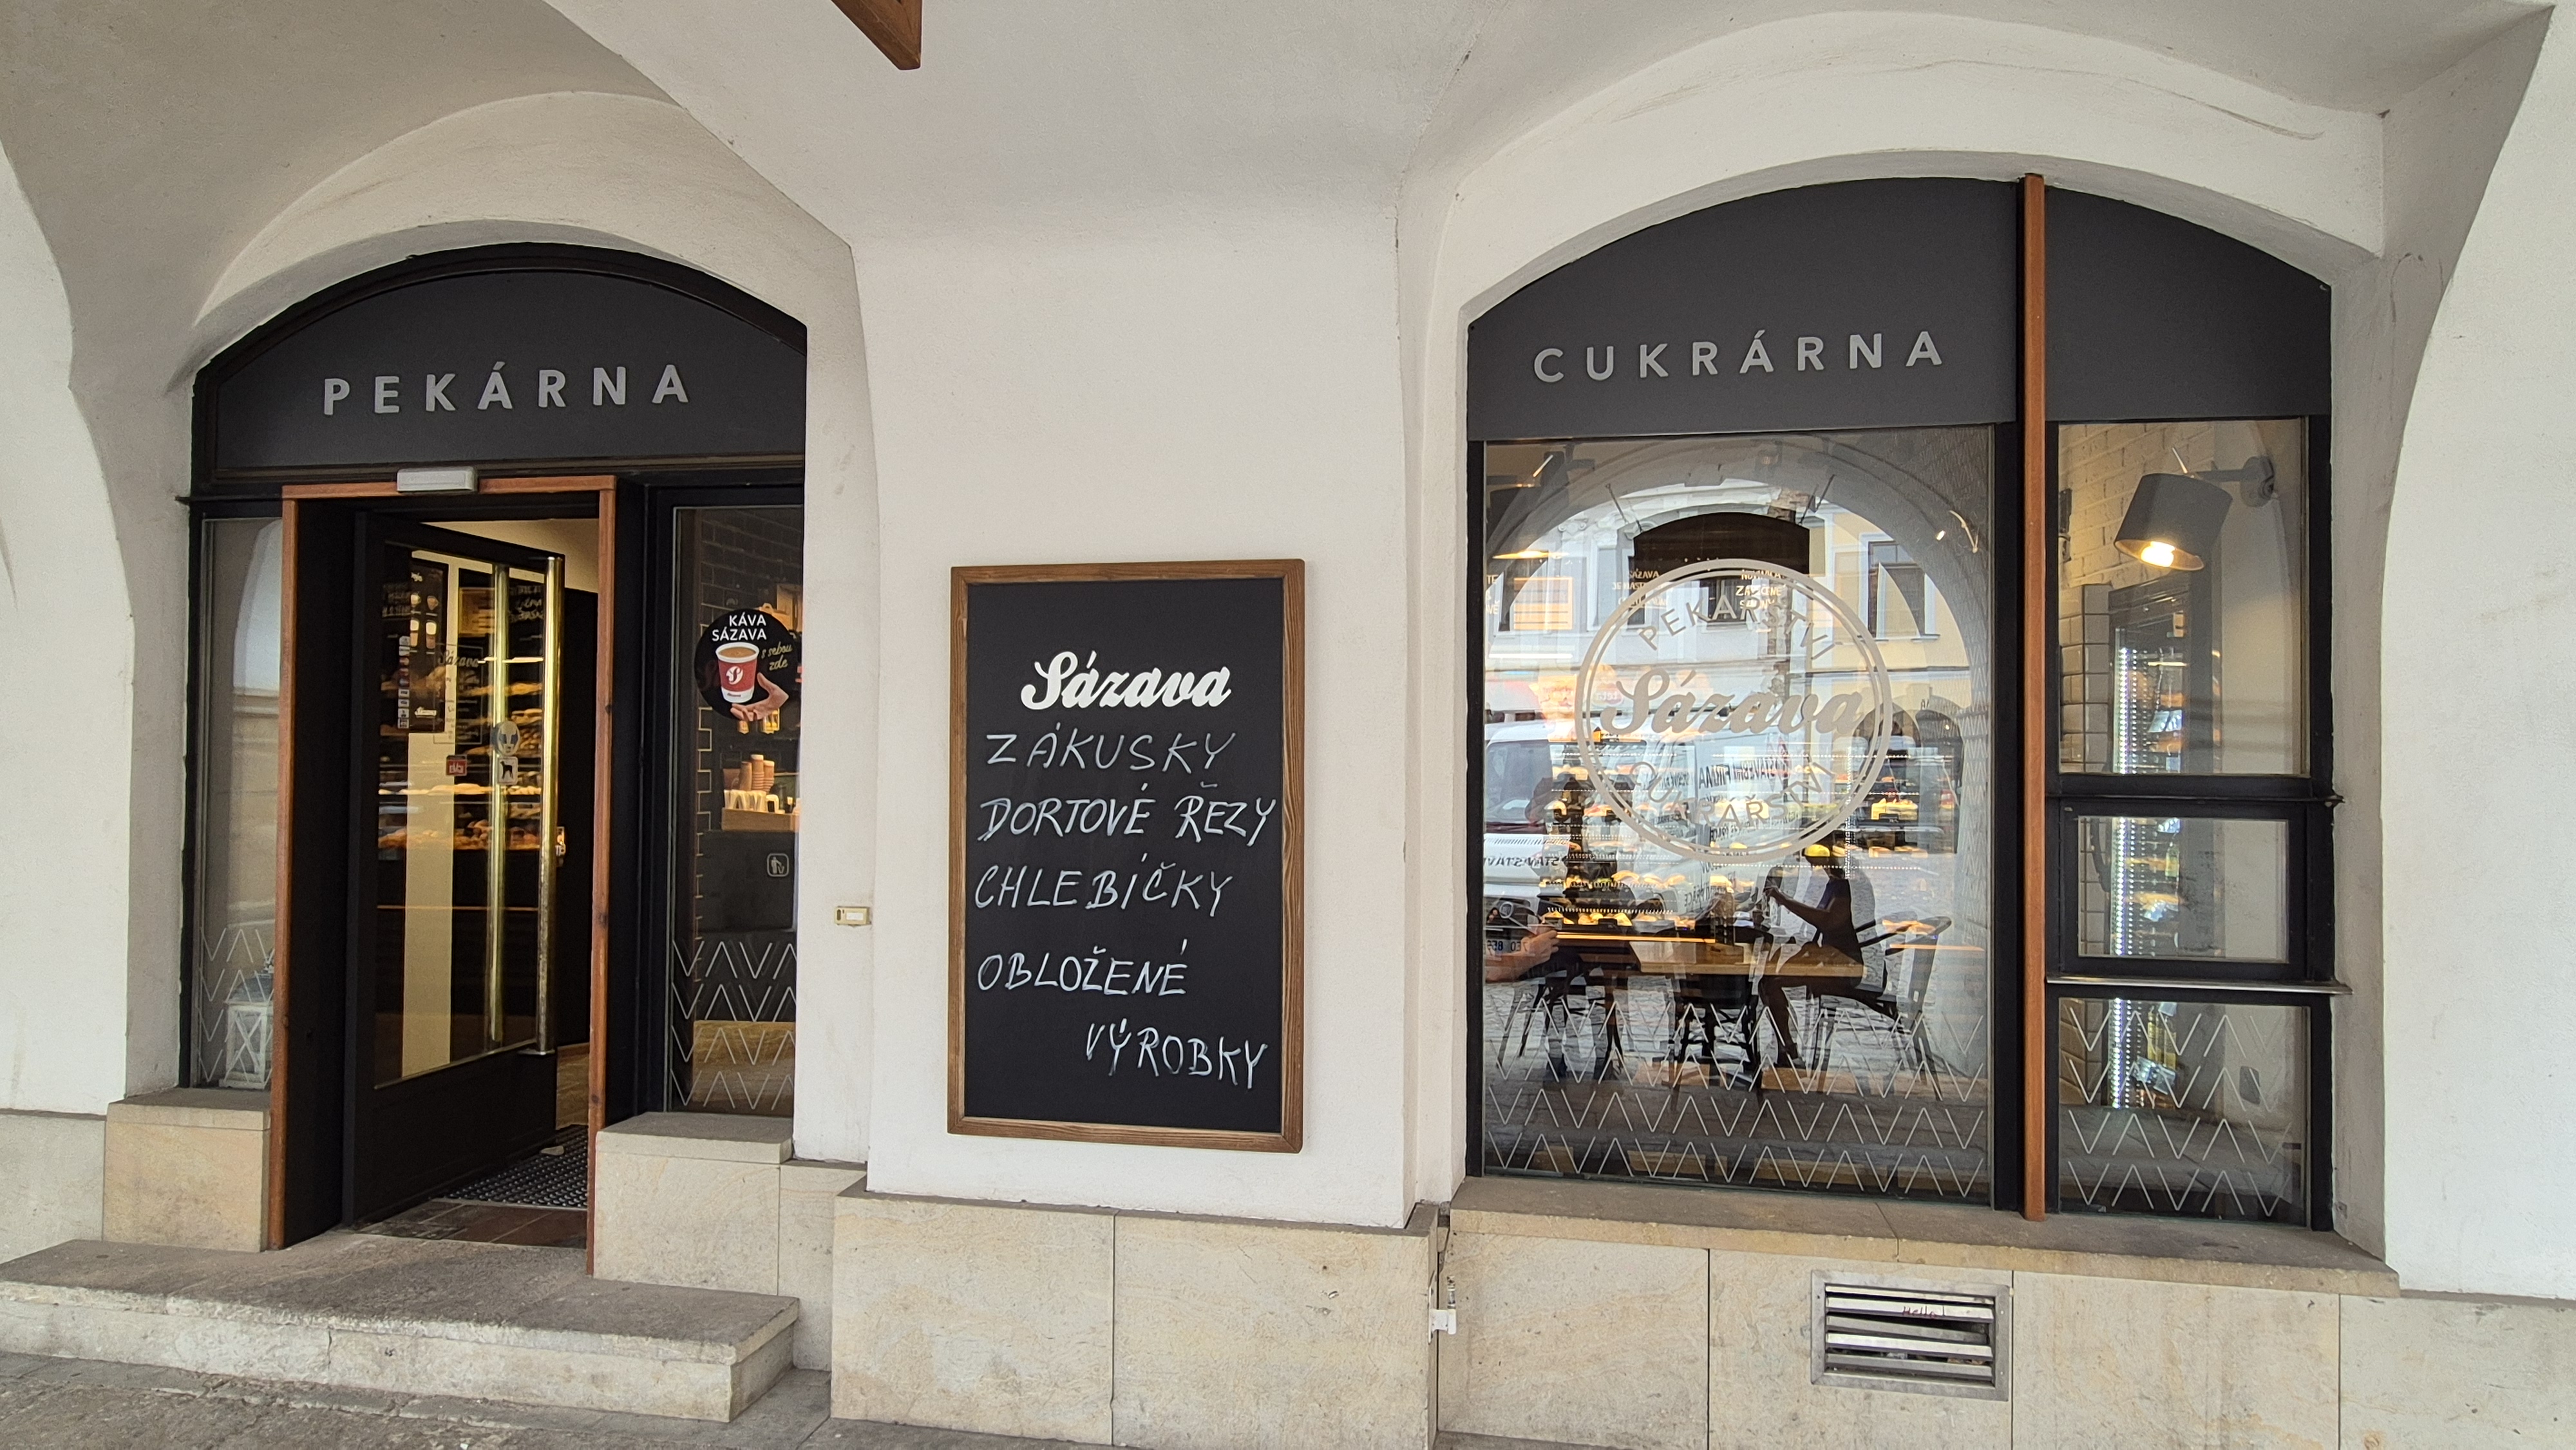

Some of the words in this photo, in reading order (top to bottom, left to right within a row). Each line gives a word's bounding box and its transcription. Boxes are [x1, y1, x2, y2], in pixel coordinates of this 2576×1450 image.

[1534, 330, 1942, 382] CUKRÁRNA
[324, 361, 688, 415] PEKÁRNA
[712, 626, 766, 641] SÁZAVA
[729, 612, 766, 626] KÁVA
[1639, 589, 1843, 660] PEKAŘSTVÍ
[761, 649, 767, 659] s
[768, 641, 793, 657] sebou
[769, 654, 788, 671] zde
[1021, 651, 1232, 710] Sázava
[1600, 668, 1866, 735] Sázava
[987, 722, 1236, 774] ZÁKUSKY
[978, 783, 1155, 842] DORTOVÉ
[1174, 781, 1276, 847] ŘEZY
[974, 852, 1233, 917] CHLEBÍČKY
[978, 939, 1188, 995] OBLOŽENÉ
[1086, 1018, 1268, 1089] VÝROBKY
